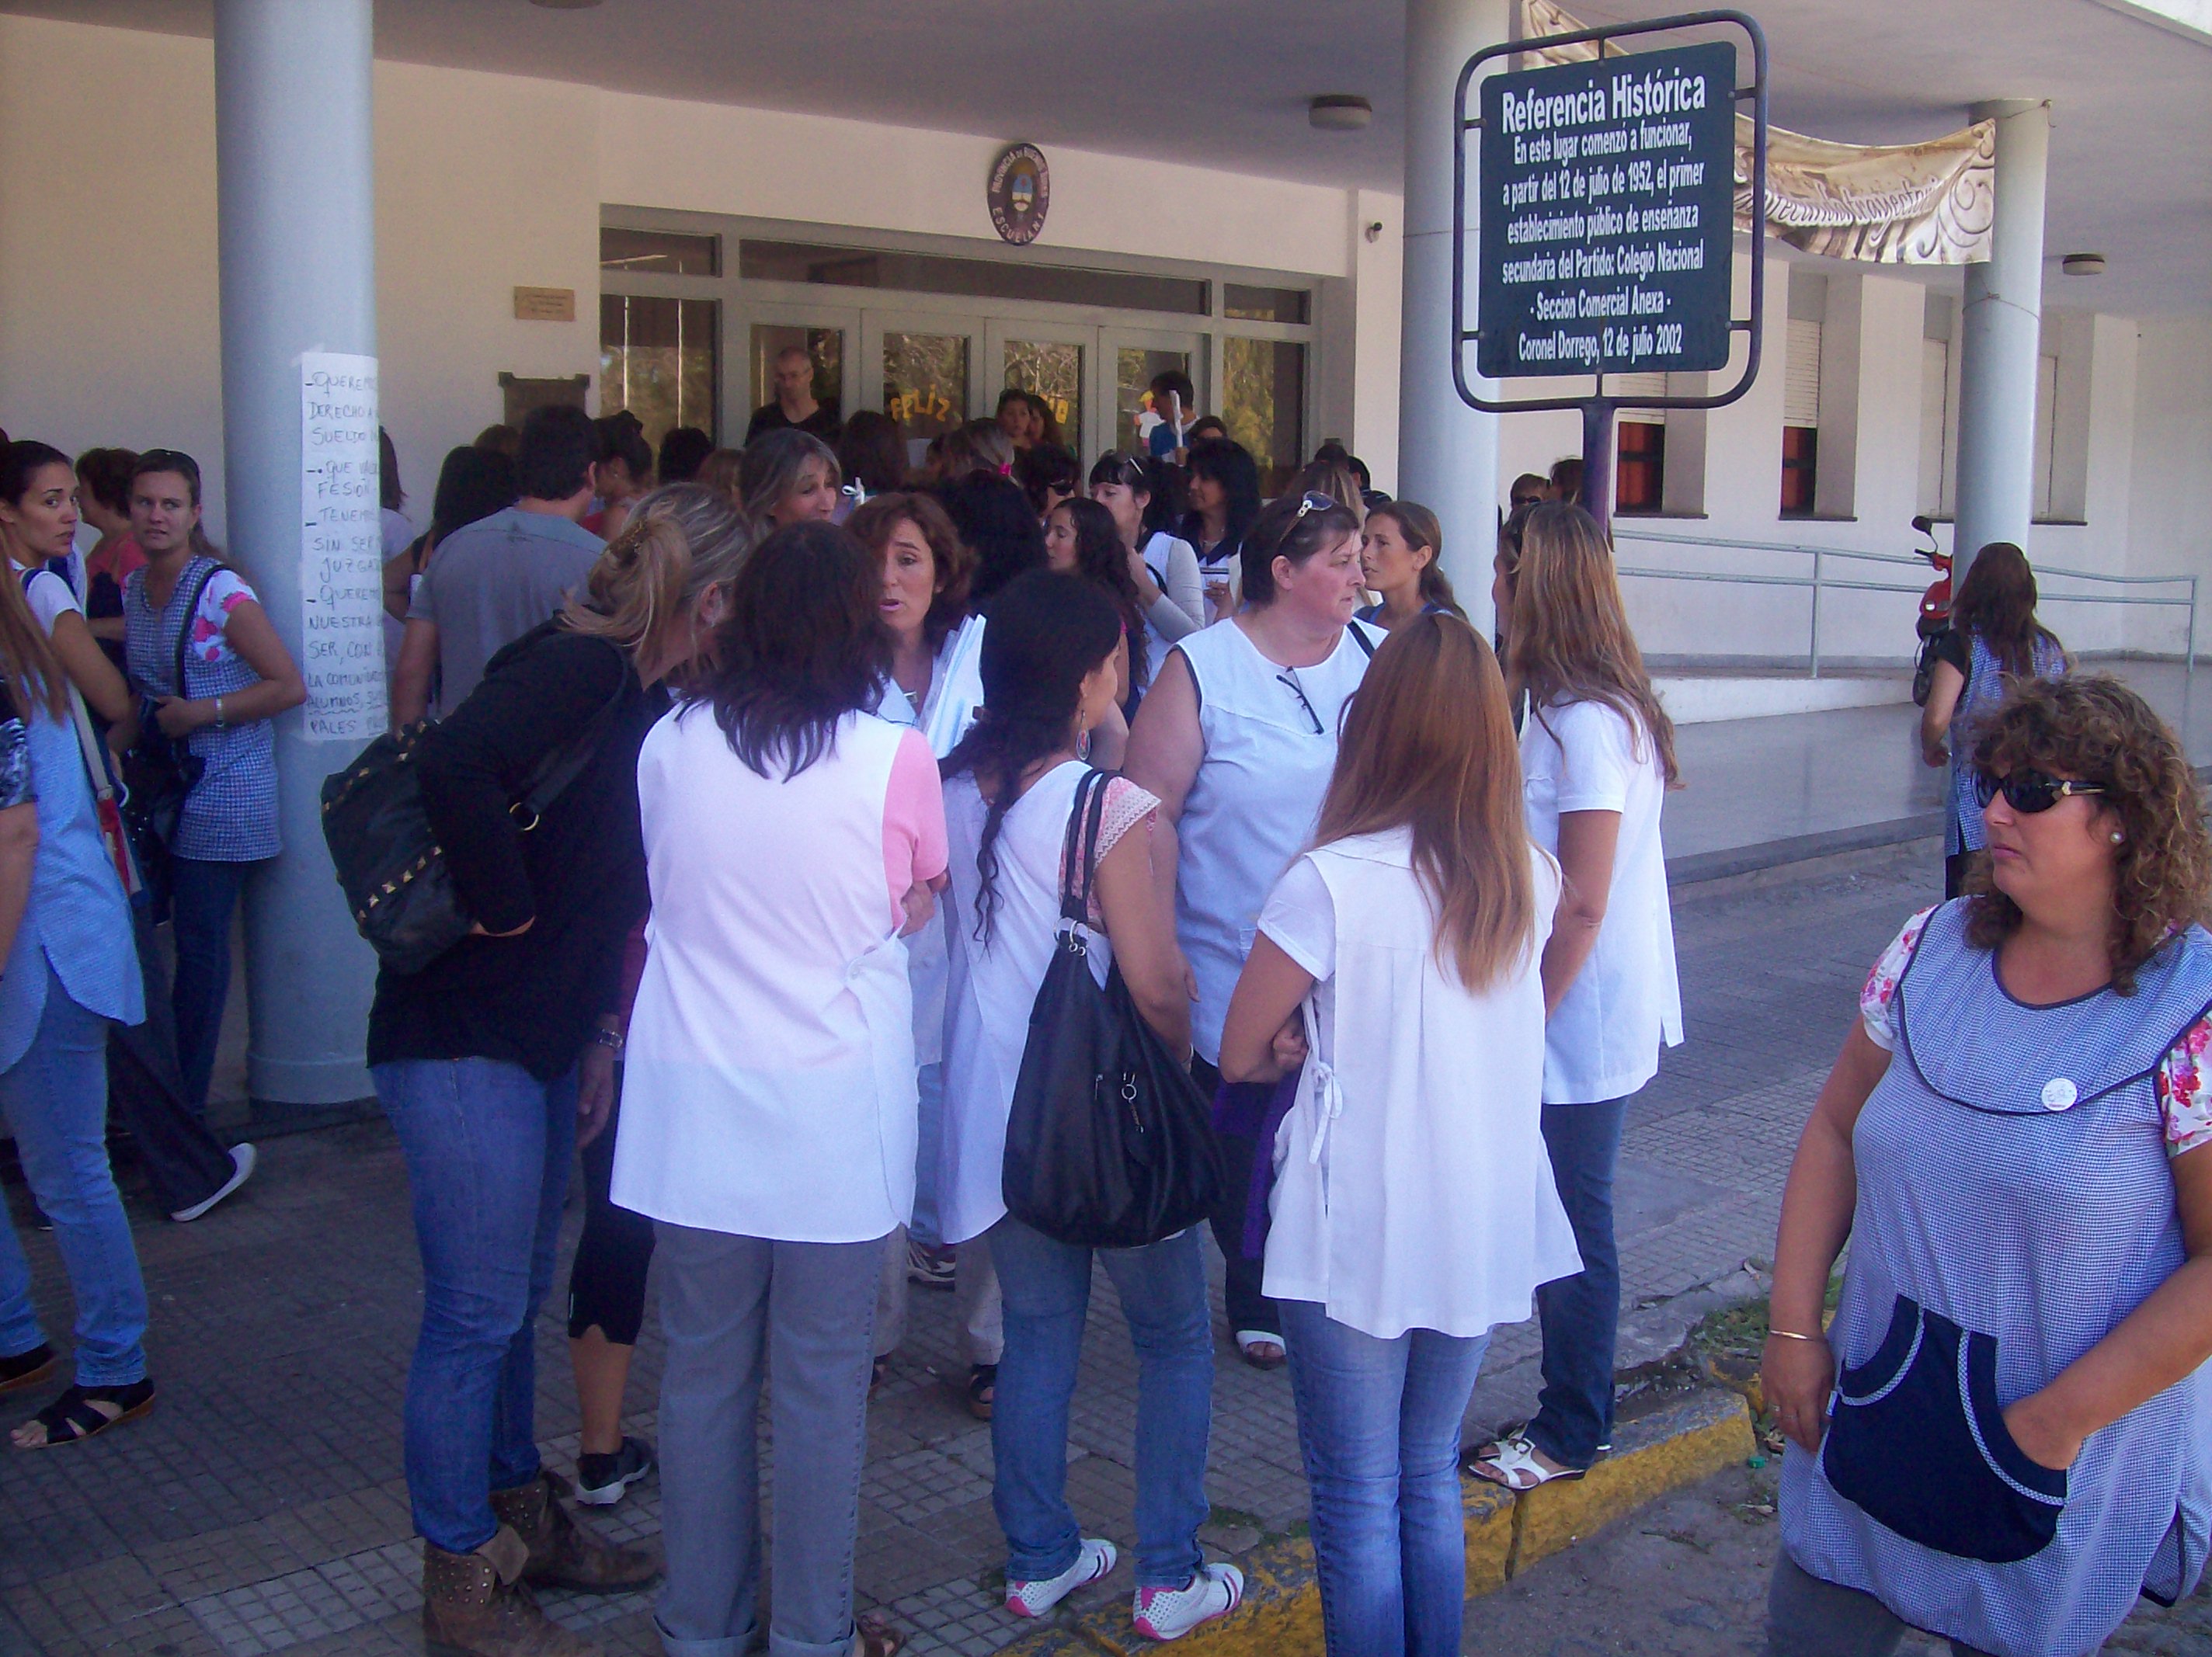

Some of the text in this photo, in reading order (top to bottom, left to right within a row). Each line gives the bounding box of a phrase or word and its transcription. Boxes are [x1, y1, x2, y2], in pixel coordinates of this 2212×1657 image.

[1502, 67, 1706, 133] Referencia Histórica
[1514, 116, 1692, 166] En este lugar comenzó a funcionar,
[1503, 157, 1705, 212] a partir del 12 de julio de 1952, el primer
[1508, 210, 1584, 245] establecimiento
[1587, 204, 1622, 245] público
[1626, 204, 1639, 234] de
[1642, 200, 1699, 231] enseñanza
[1502, 238, 1704, 284] secundaria del Partido: Colegio Nacional
[1536, 284, 1664, 321] Seccion Comercial Anexa
[1518, 323, 1682, 366] Coronel Dorrego, 12 de julio 2002
[308, 401, 364, 419] DERECHO
[311, 427, 366, 446] SUELDO
[325, 460, 353, 481] QUE
[313, 537, 340, 551] SIN
[346, 641, 372, 658] CON
[307, 672, 323, 688] LA
[310, 720, 356, 735] PALES
